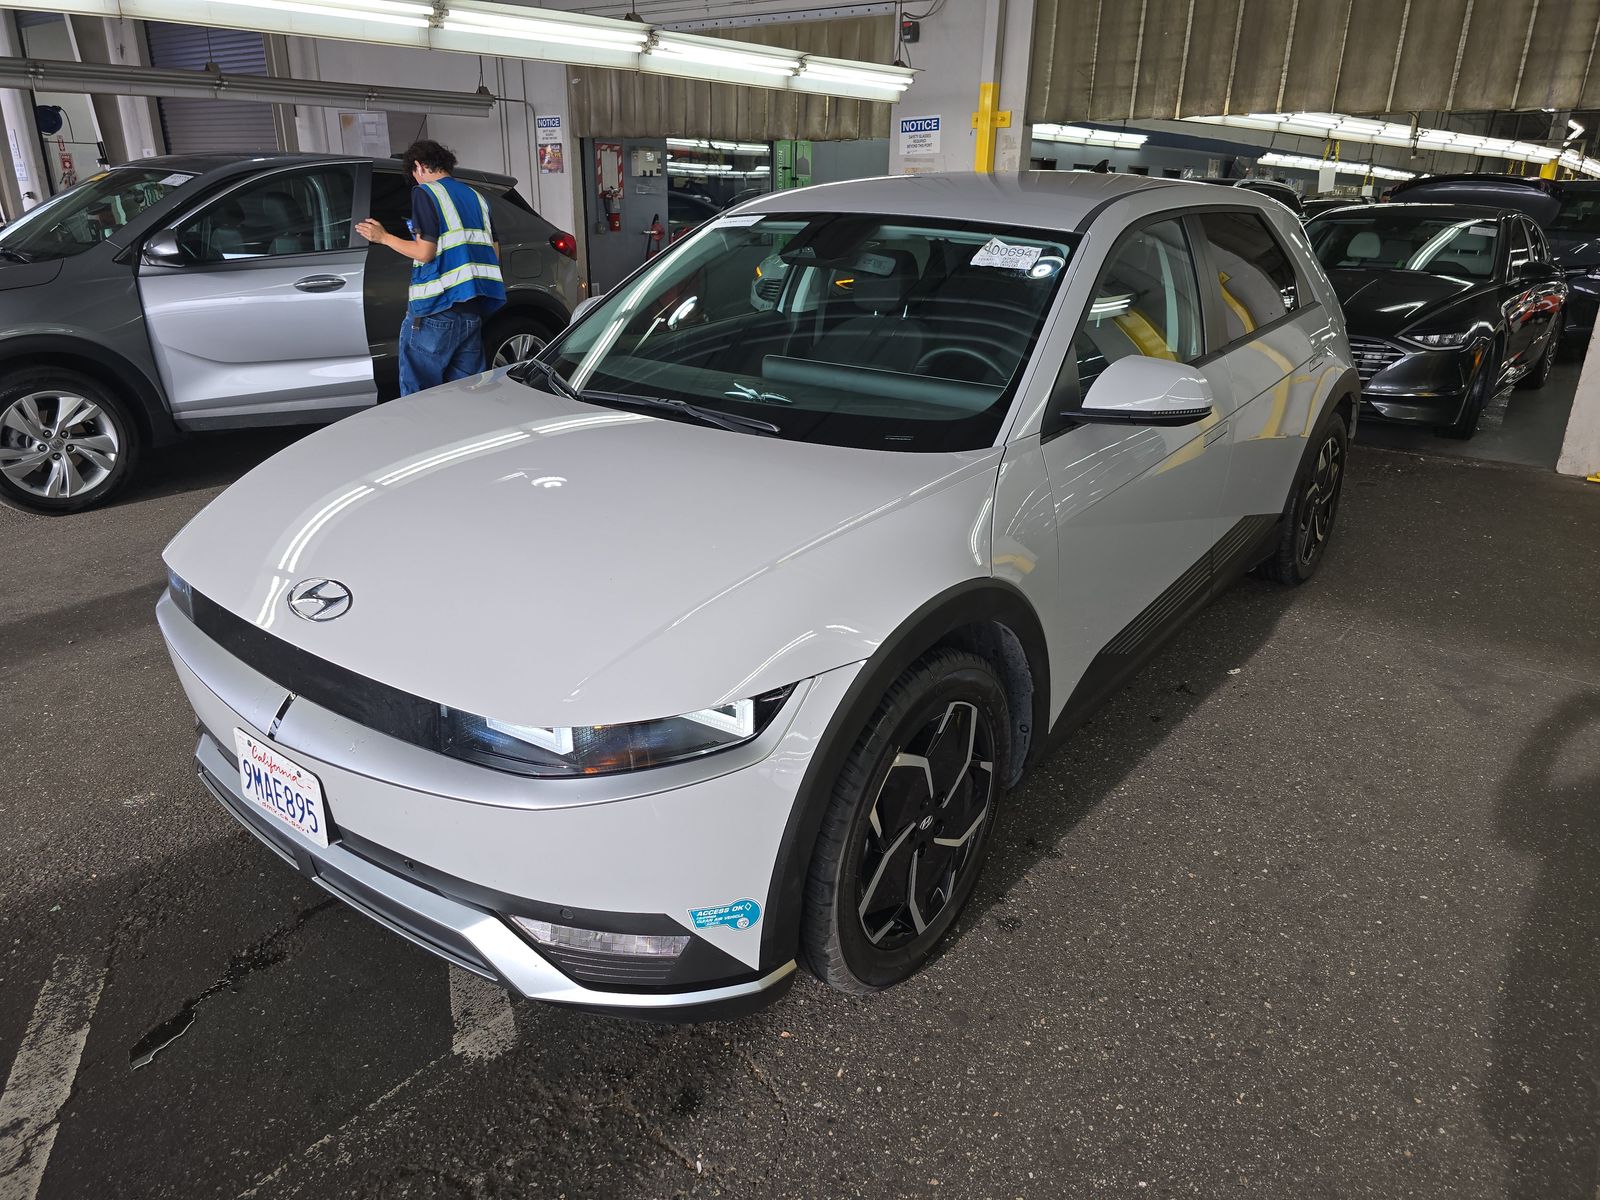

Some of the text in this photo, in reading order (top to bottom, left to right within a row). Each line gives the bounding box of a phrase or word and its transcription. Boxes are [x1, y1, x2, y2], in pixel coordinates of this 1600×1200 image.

[538, 118, 560, 127] NOTICE
[902, 119, 938, 132] NOTICE
[252, 745, 304, 788] California
[243, 759, 318, 833] 9MAE895
[697, 907, 730, 916] ACCESS
